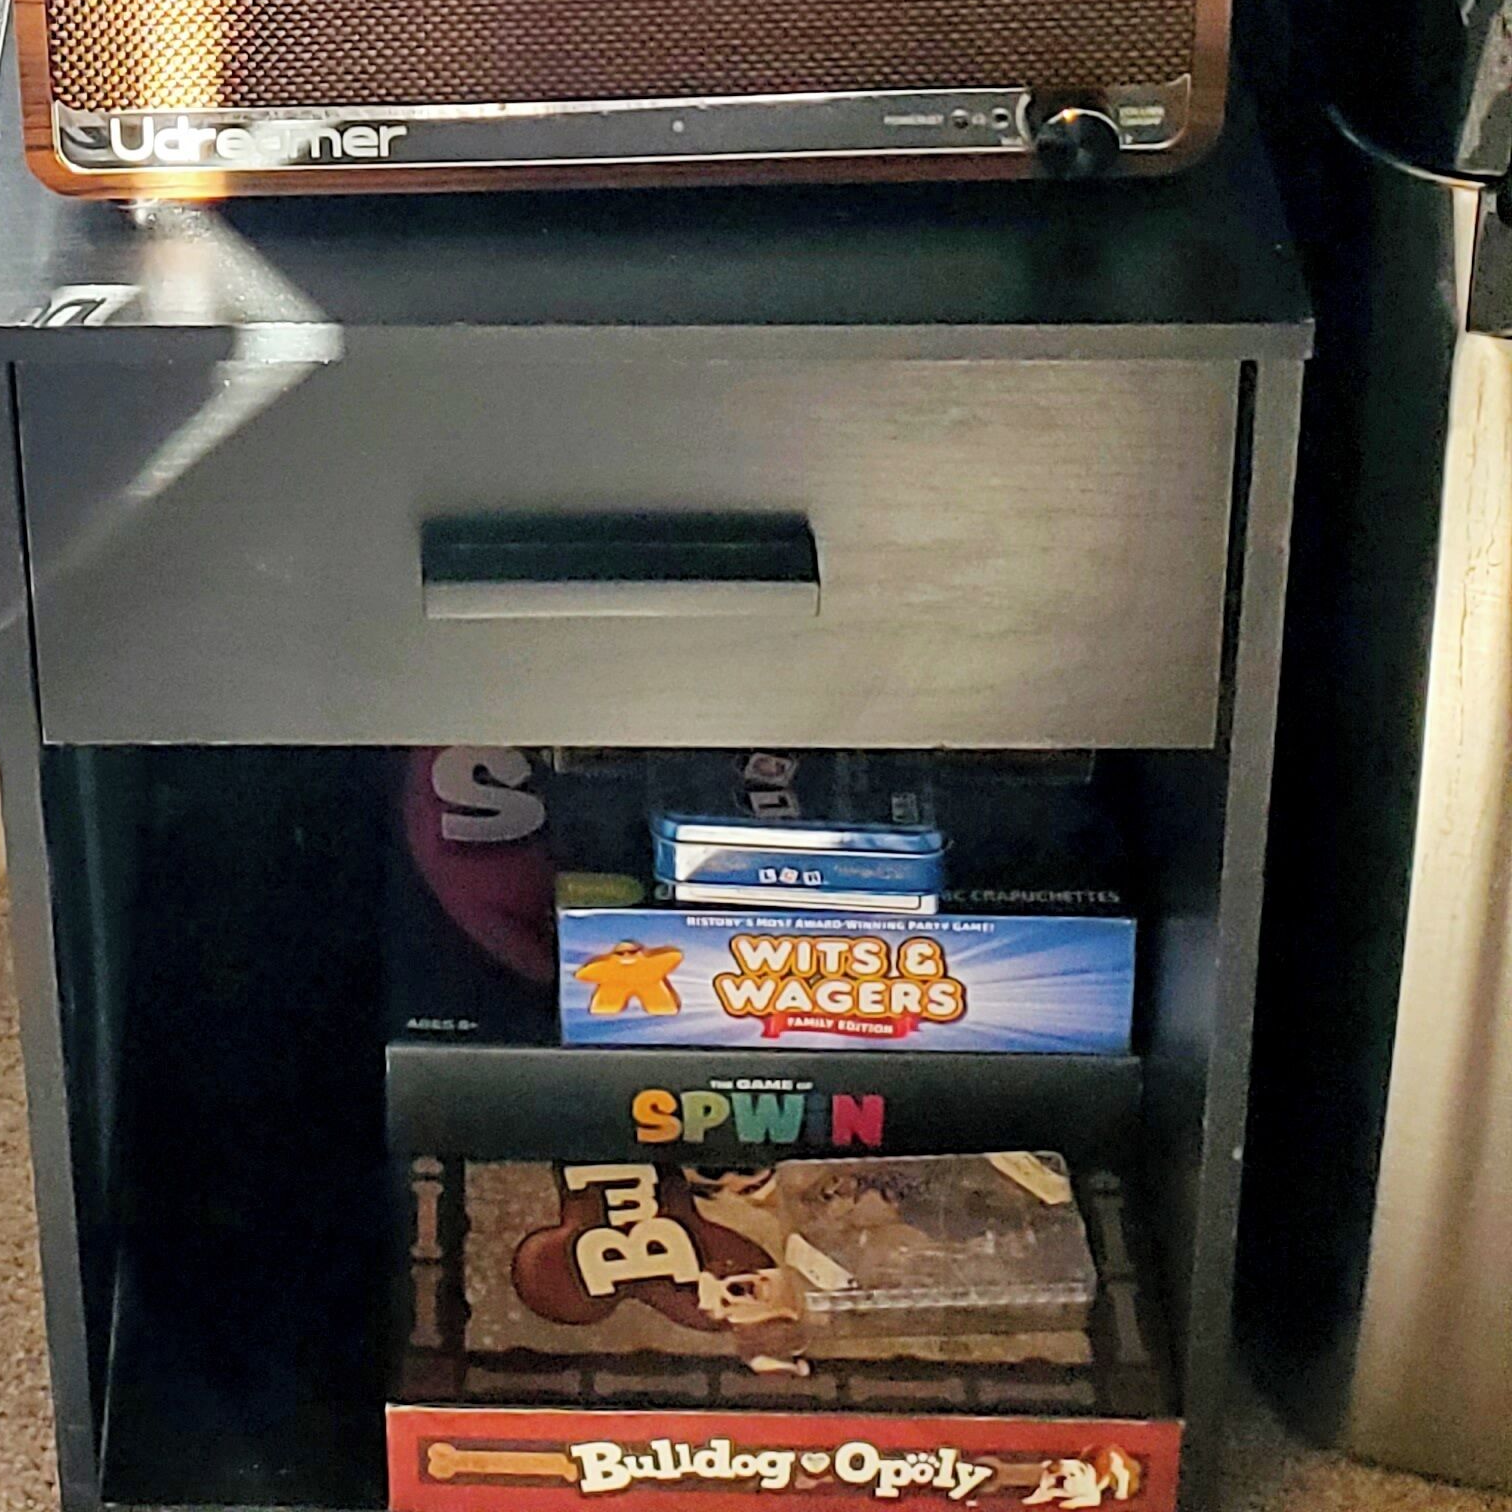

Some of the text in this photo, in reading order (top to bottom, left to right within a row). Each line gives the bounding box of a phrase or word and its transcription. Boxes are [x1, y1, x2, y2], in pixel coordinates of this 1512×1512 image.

[734, 937, 941, 978] WITS &
[719, 976, 964, 1017] WAGERS
[788, 1016, 894, 1034] FAMILY EDITION
[736, 1080, 793, 1090] GAME
[571, 1438, 795, 1492] Bulldog
